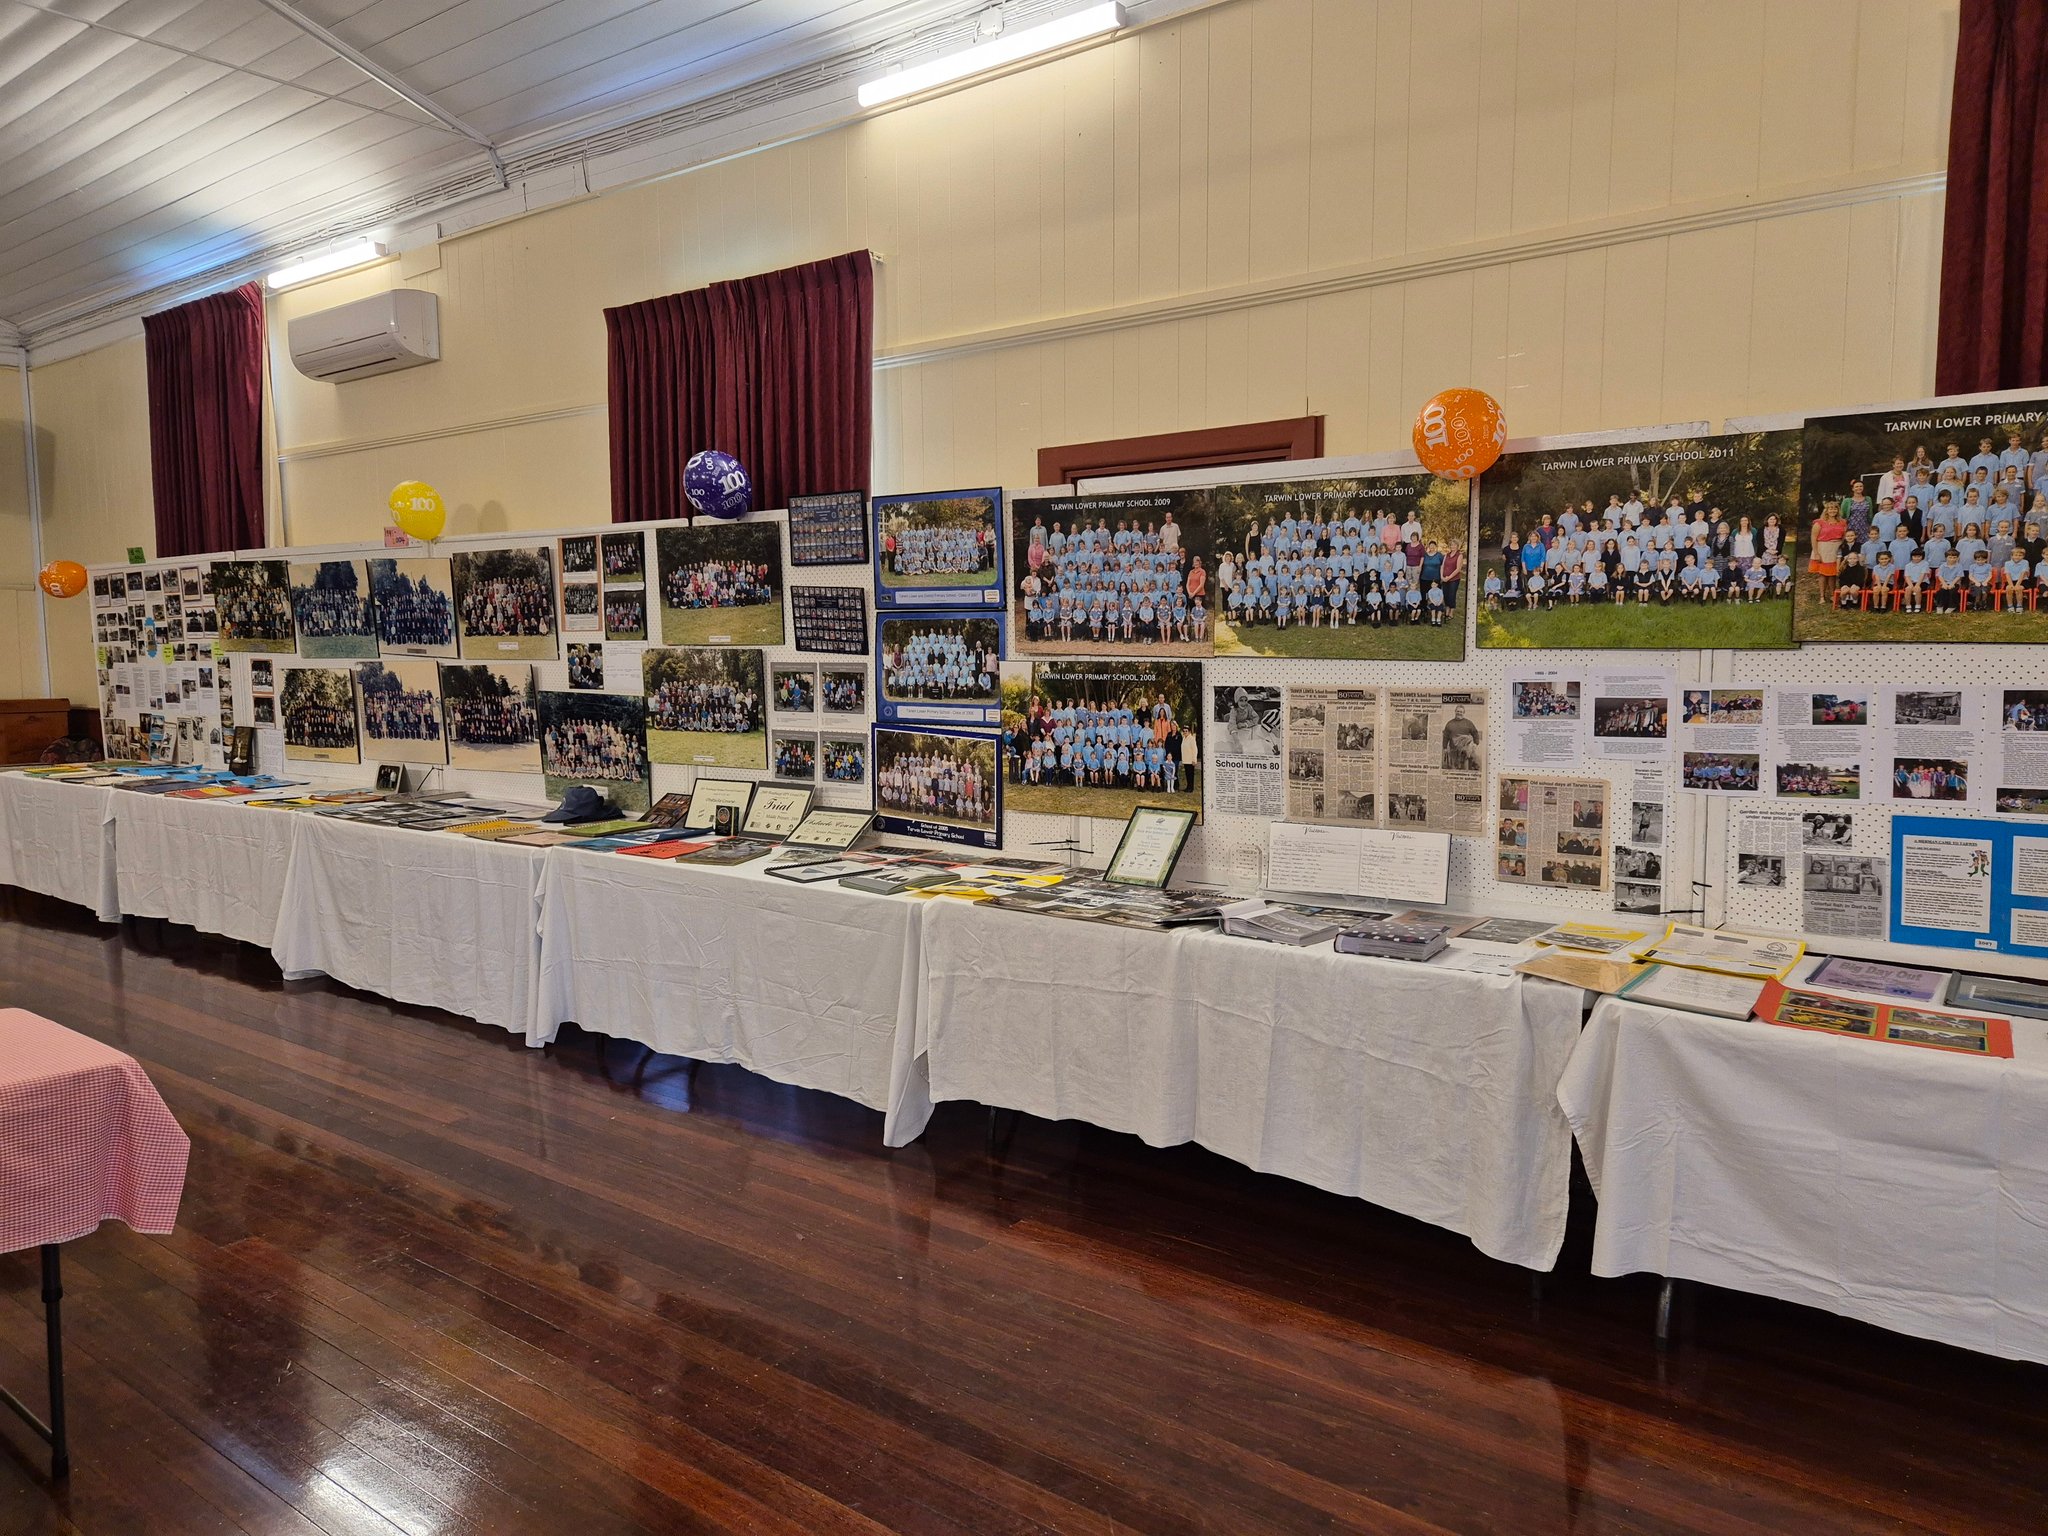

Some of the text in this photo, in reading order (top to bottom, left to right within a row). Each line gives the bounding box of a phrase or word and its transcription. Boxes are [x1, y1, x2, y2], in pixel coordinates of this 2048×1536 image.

[1424, 405, 1449, 450] 100
[1884, 419, 1931, 432] TARWIN
[1935, 415, 1981, 429] LOWER
[1985, 411, 2043, 425] PRIMARY
[1451, 417, 1472, 448] 100
[705, 458, 714, 470] 100
[1455, 448, 1474, 464] 100
[1541, 449, 1735, 471] TARWIN LOWER PRIMARY SCHOOL 2011
[718, 470, 746, 495] 100
[1264, 487, 1414, 502] TARWIN LOWER PRIMARY SCHOOL 2010
[410, 497, 437, 511] 100
[1098, 500, 1125, 508] PRIMARY
[1127, 499, 1152, 507] SCHOOL
[1154, 498, 1171, 506] 2009
[1215, 759, 1244, 768] School
[1269, 762, 1280, 770] 80
[763, 798, 794, 811] Trial
[1839, 962, 1923, 981] Big Day Out
